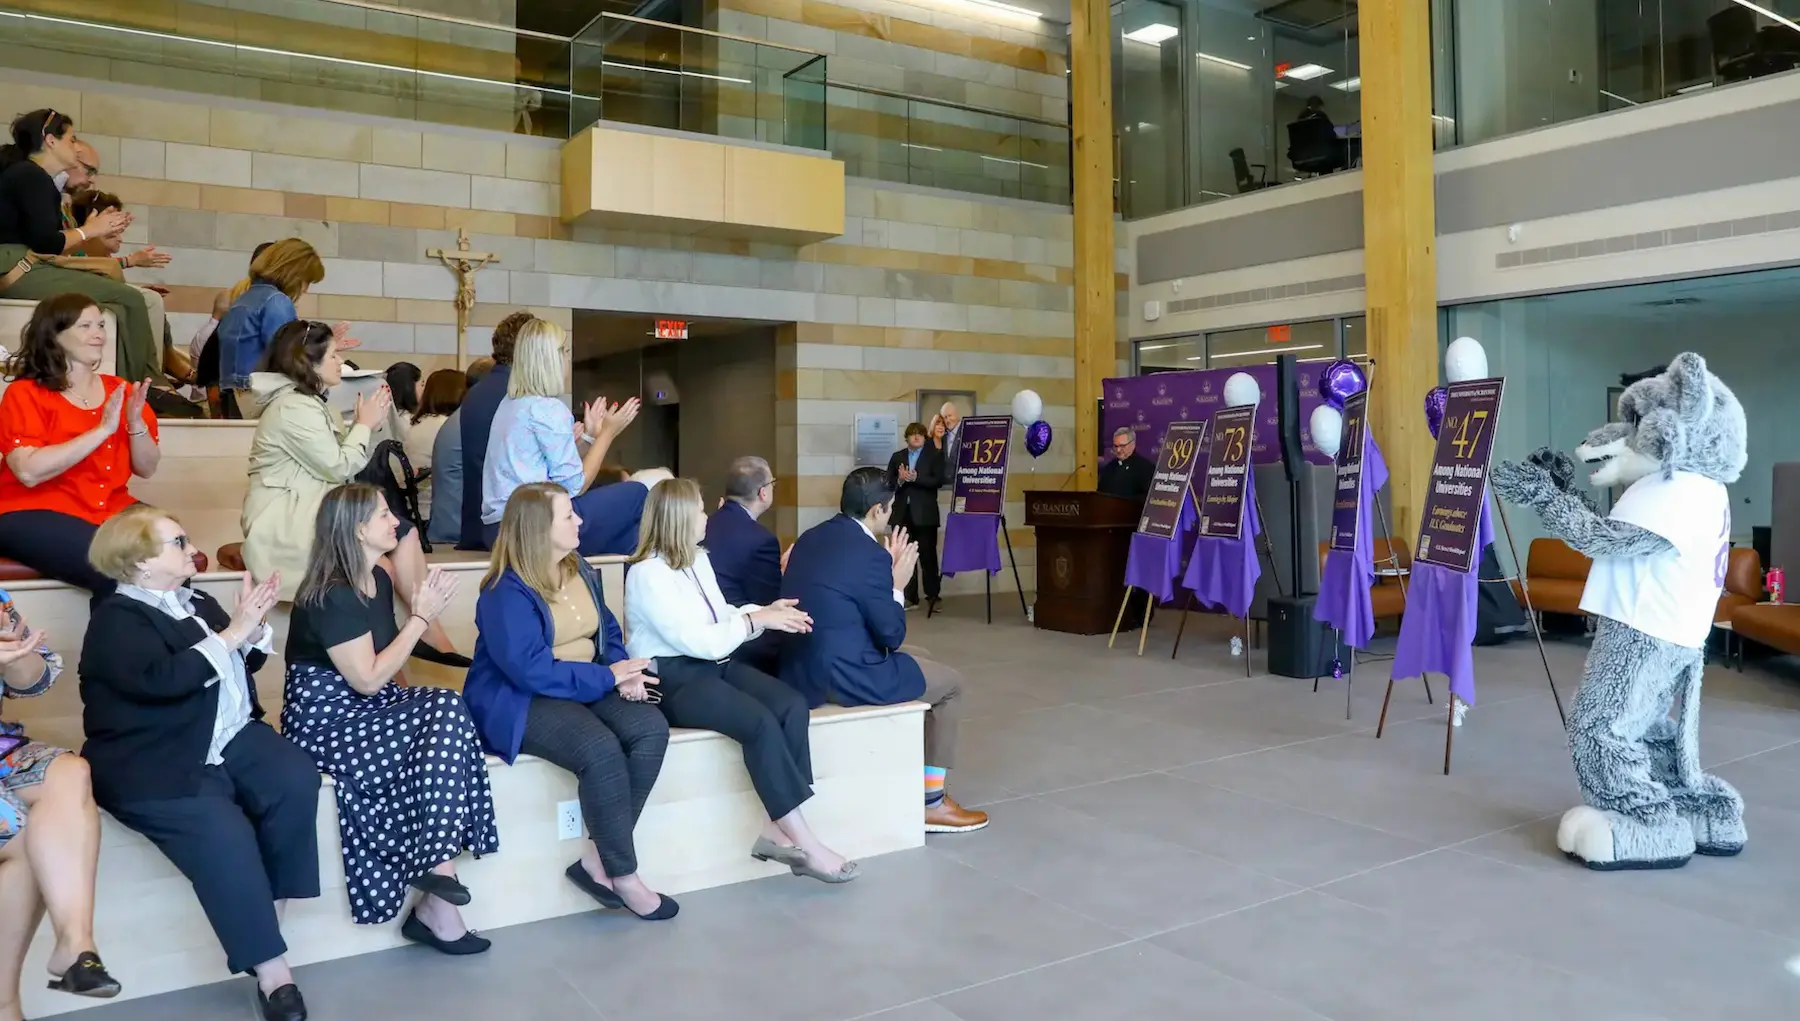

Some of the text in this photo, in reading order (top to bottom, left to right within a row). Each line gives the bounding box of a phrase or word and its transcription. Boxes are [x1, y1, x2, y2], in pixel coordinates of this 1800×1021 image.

[659, 319, 685, 337] EXIT
[1346, 417, 1360, 458] 71
[1446, 409, 1488, 459] NO. 47
[970, 438, 1006, 464] 137
[1223, 426, 1245, 462] 73
[1167, 438, 1194, 469] 89
[958, 466, 1004, 476] Among National
[1154, 471, 1188, 482] Among National
[1208, 464, 1245, 477] Among National
[1433, 463, 1484, 480] Among National
[962, 476, 997, 485] Universities
[1155, 482, 1180, 493] Universities
[1210, 477, 1238, 488] Universities
[1435, 481, 1473, 497] Universities
[1032, 500, 1080, 516] SCRANTON
